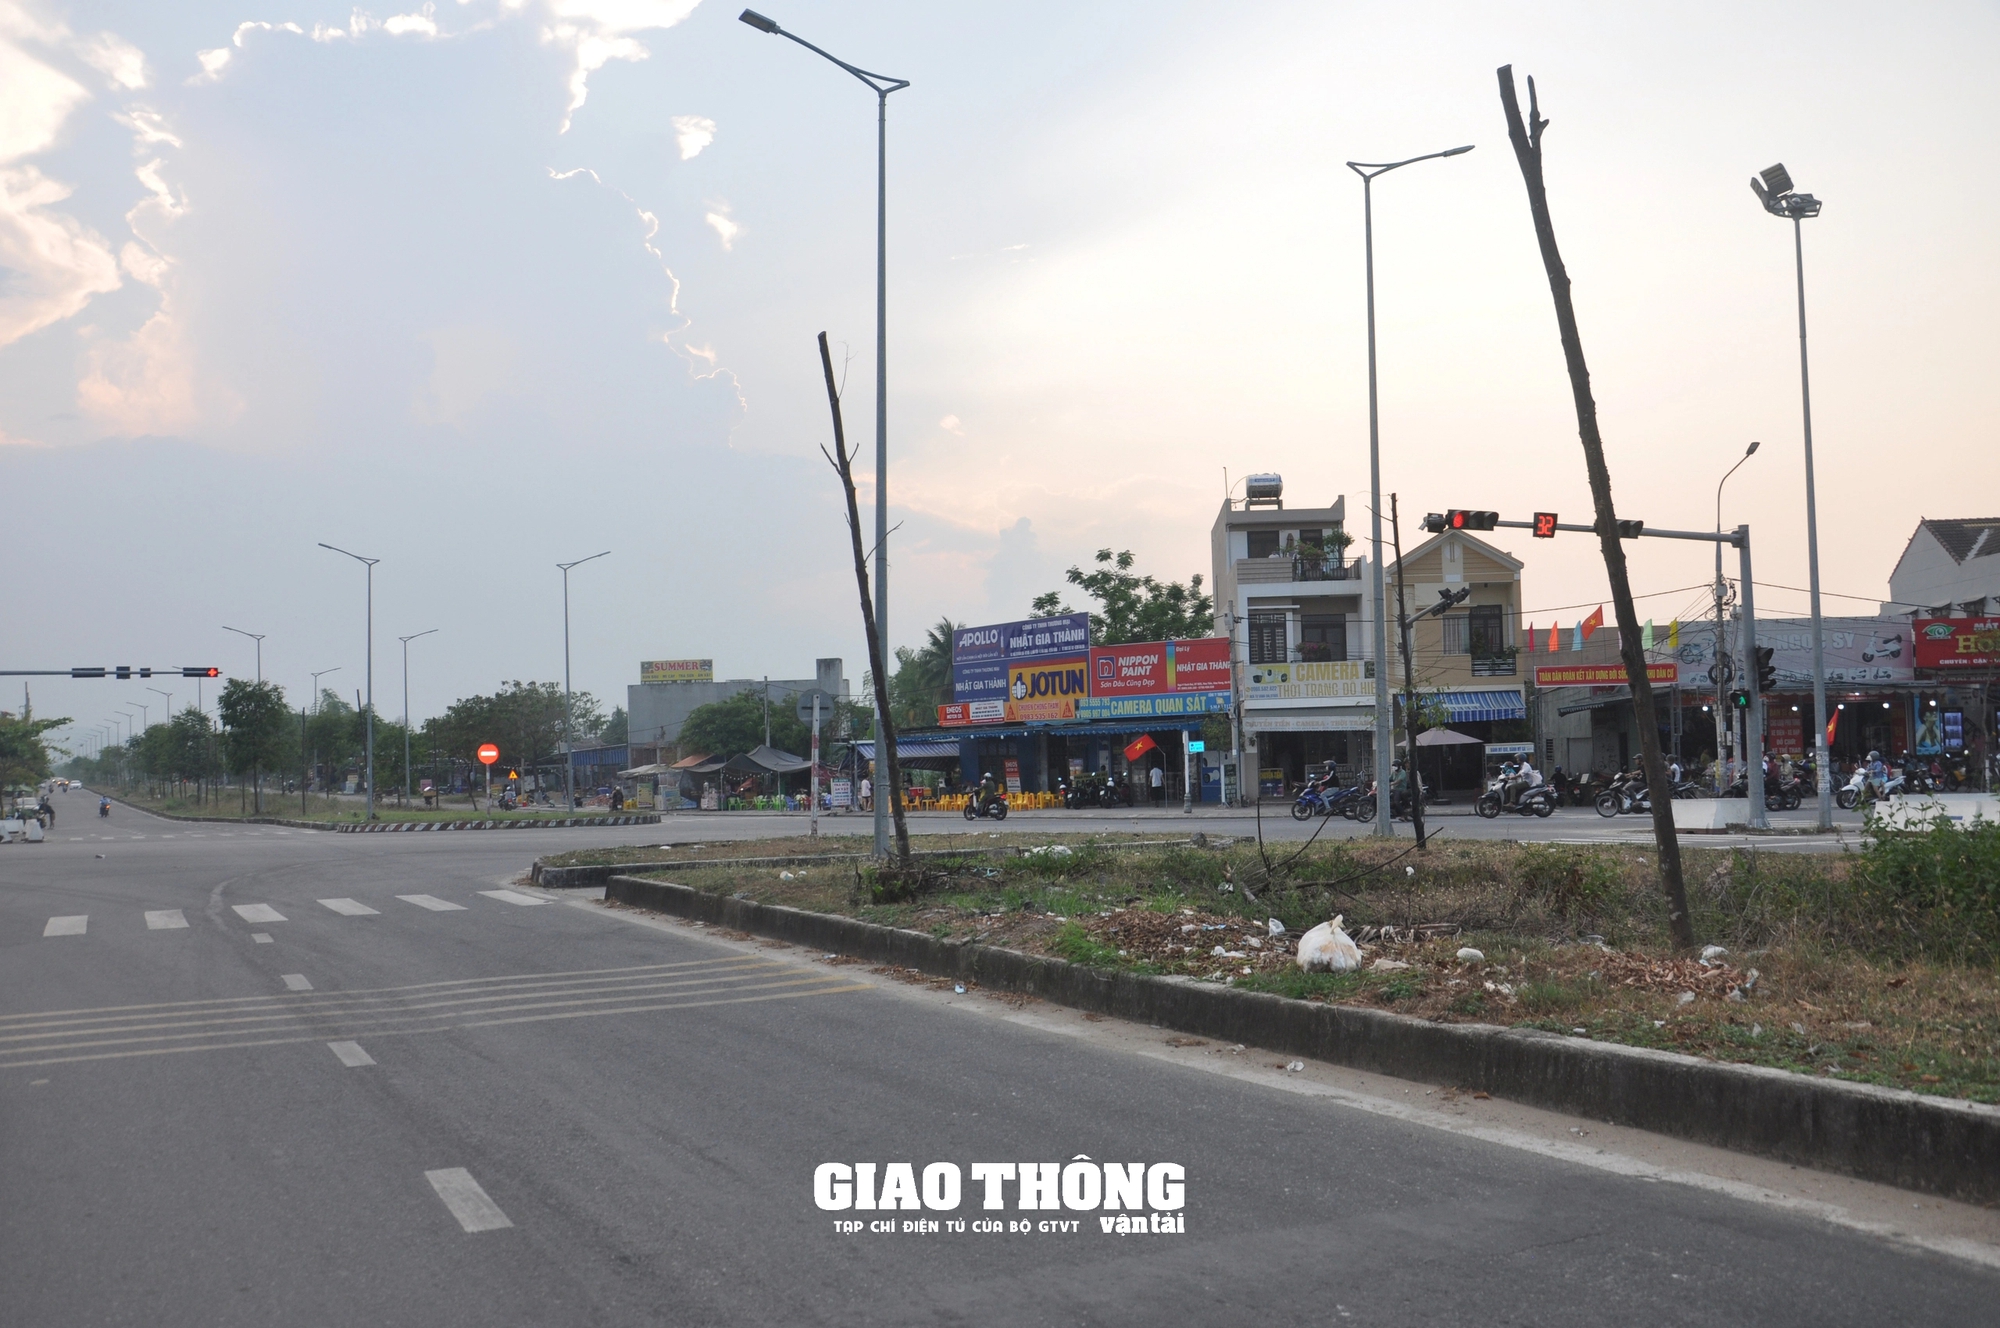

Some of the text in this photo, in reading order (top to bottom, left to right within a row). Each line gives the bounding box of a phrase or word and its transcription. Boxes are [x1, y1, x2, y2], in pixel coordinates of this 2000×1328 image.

[1537, 516, 1554, 535] 32
[959, 630, 998, 648] APOLLO
[1010, 628, 1084, 649] NHẬT GIA THÀNH
[1832, 632, 1855, 650] SY
[654, 661, 699, 671] SUMMER
[1118, 654, 1158, 667] NIPPON
[1177, 662, 1196, 673] NHẬT
[1196, 662, 1208, 671] GIA
[1121, 666, 1152, 677] PAINT
[1296, 662, 1359, 682] CAMERA
[1539, 670, 1551, 682] TOÀN
[1552, 670, 1562, 681] DÂN
[1563, 670, 1575, 681] ĐOÀN
[1576, 668, 1584, 680] KẾT
[1586, 668, 1594, 680] XÂY
[1656, 668, 1666, 678] DÂN
[1667, 668, 1674, 678] CƯ
[956, 677, 1006, 692] NHẬT GIA THÀNH
[1028, 669, 1084, 698] JOTUN
[1142, 679, 1155, 687] Đẹp
[1304, 682, 1338, 697] TRANG
[1111, 694, 1206, 715] CAMERA QUAN SÁT
